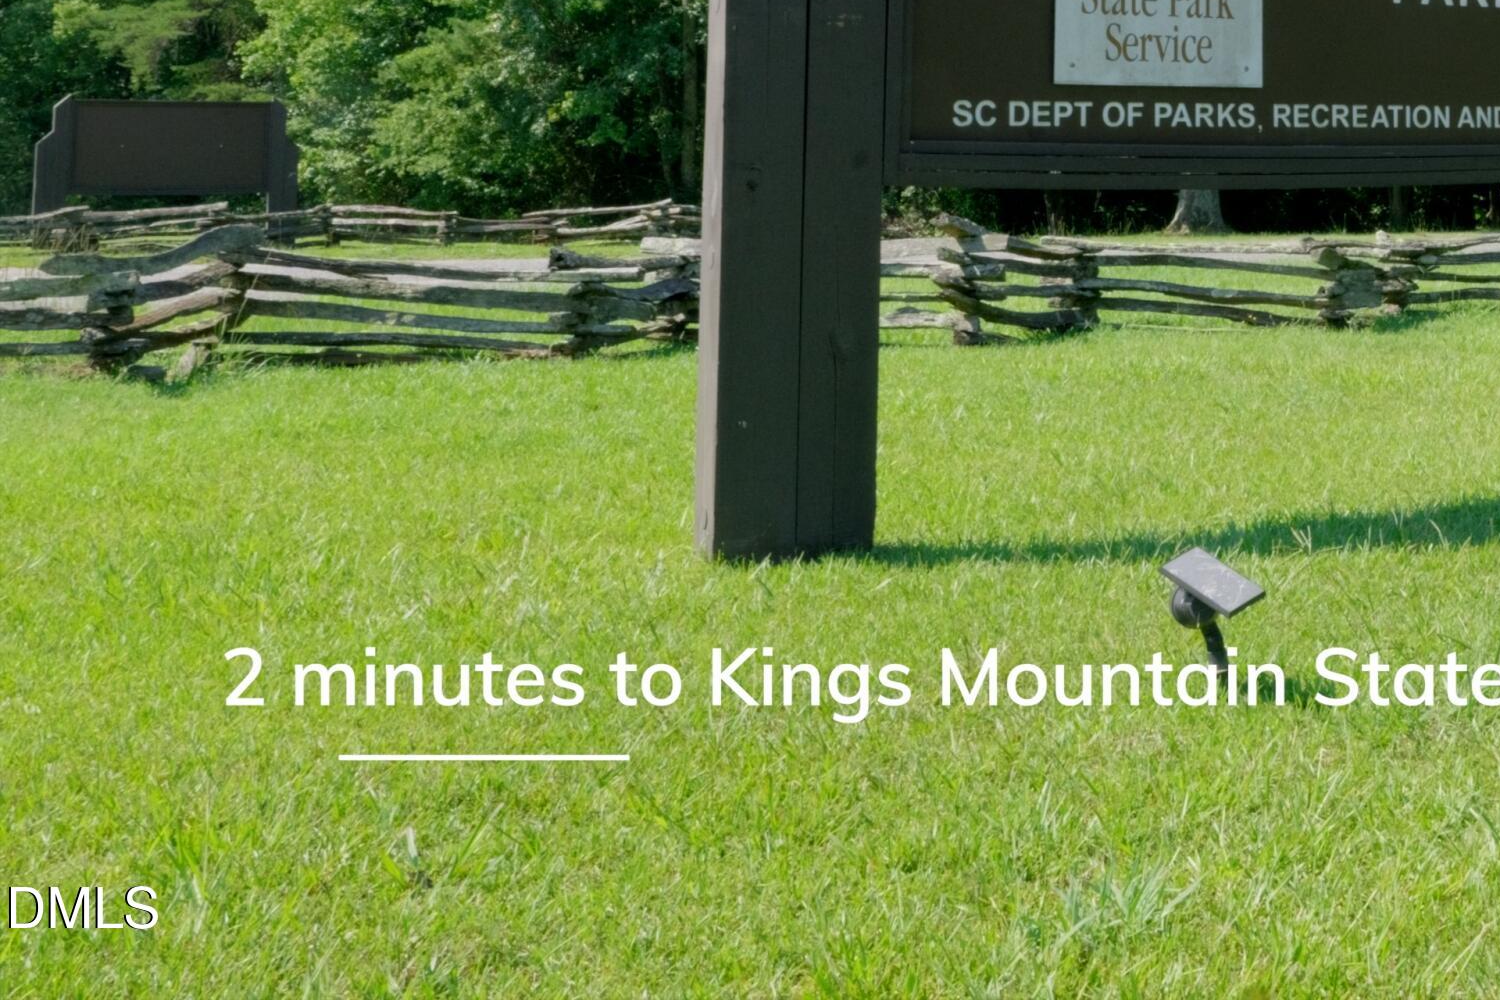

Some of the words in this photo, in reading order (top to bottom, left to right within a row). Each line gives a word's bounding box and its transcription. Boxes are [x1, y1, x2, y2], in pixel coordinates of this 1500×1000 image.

[1105, 22, 1213, 65] Service
[952, 99, 997, 127] SC
[1009, 100, 1093, 127] DEPT
[1102, 101, 1144, 127] OF
[1154, 102, 1264, 134] PARKS,
[1273, 103, 1450, 129] RECREATION
